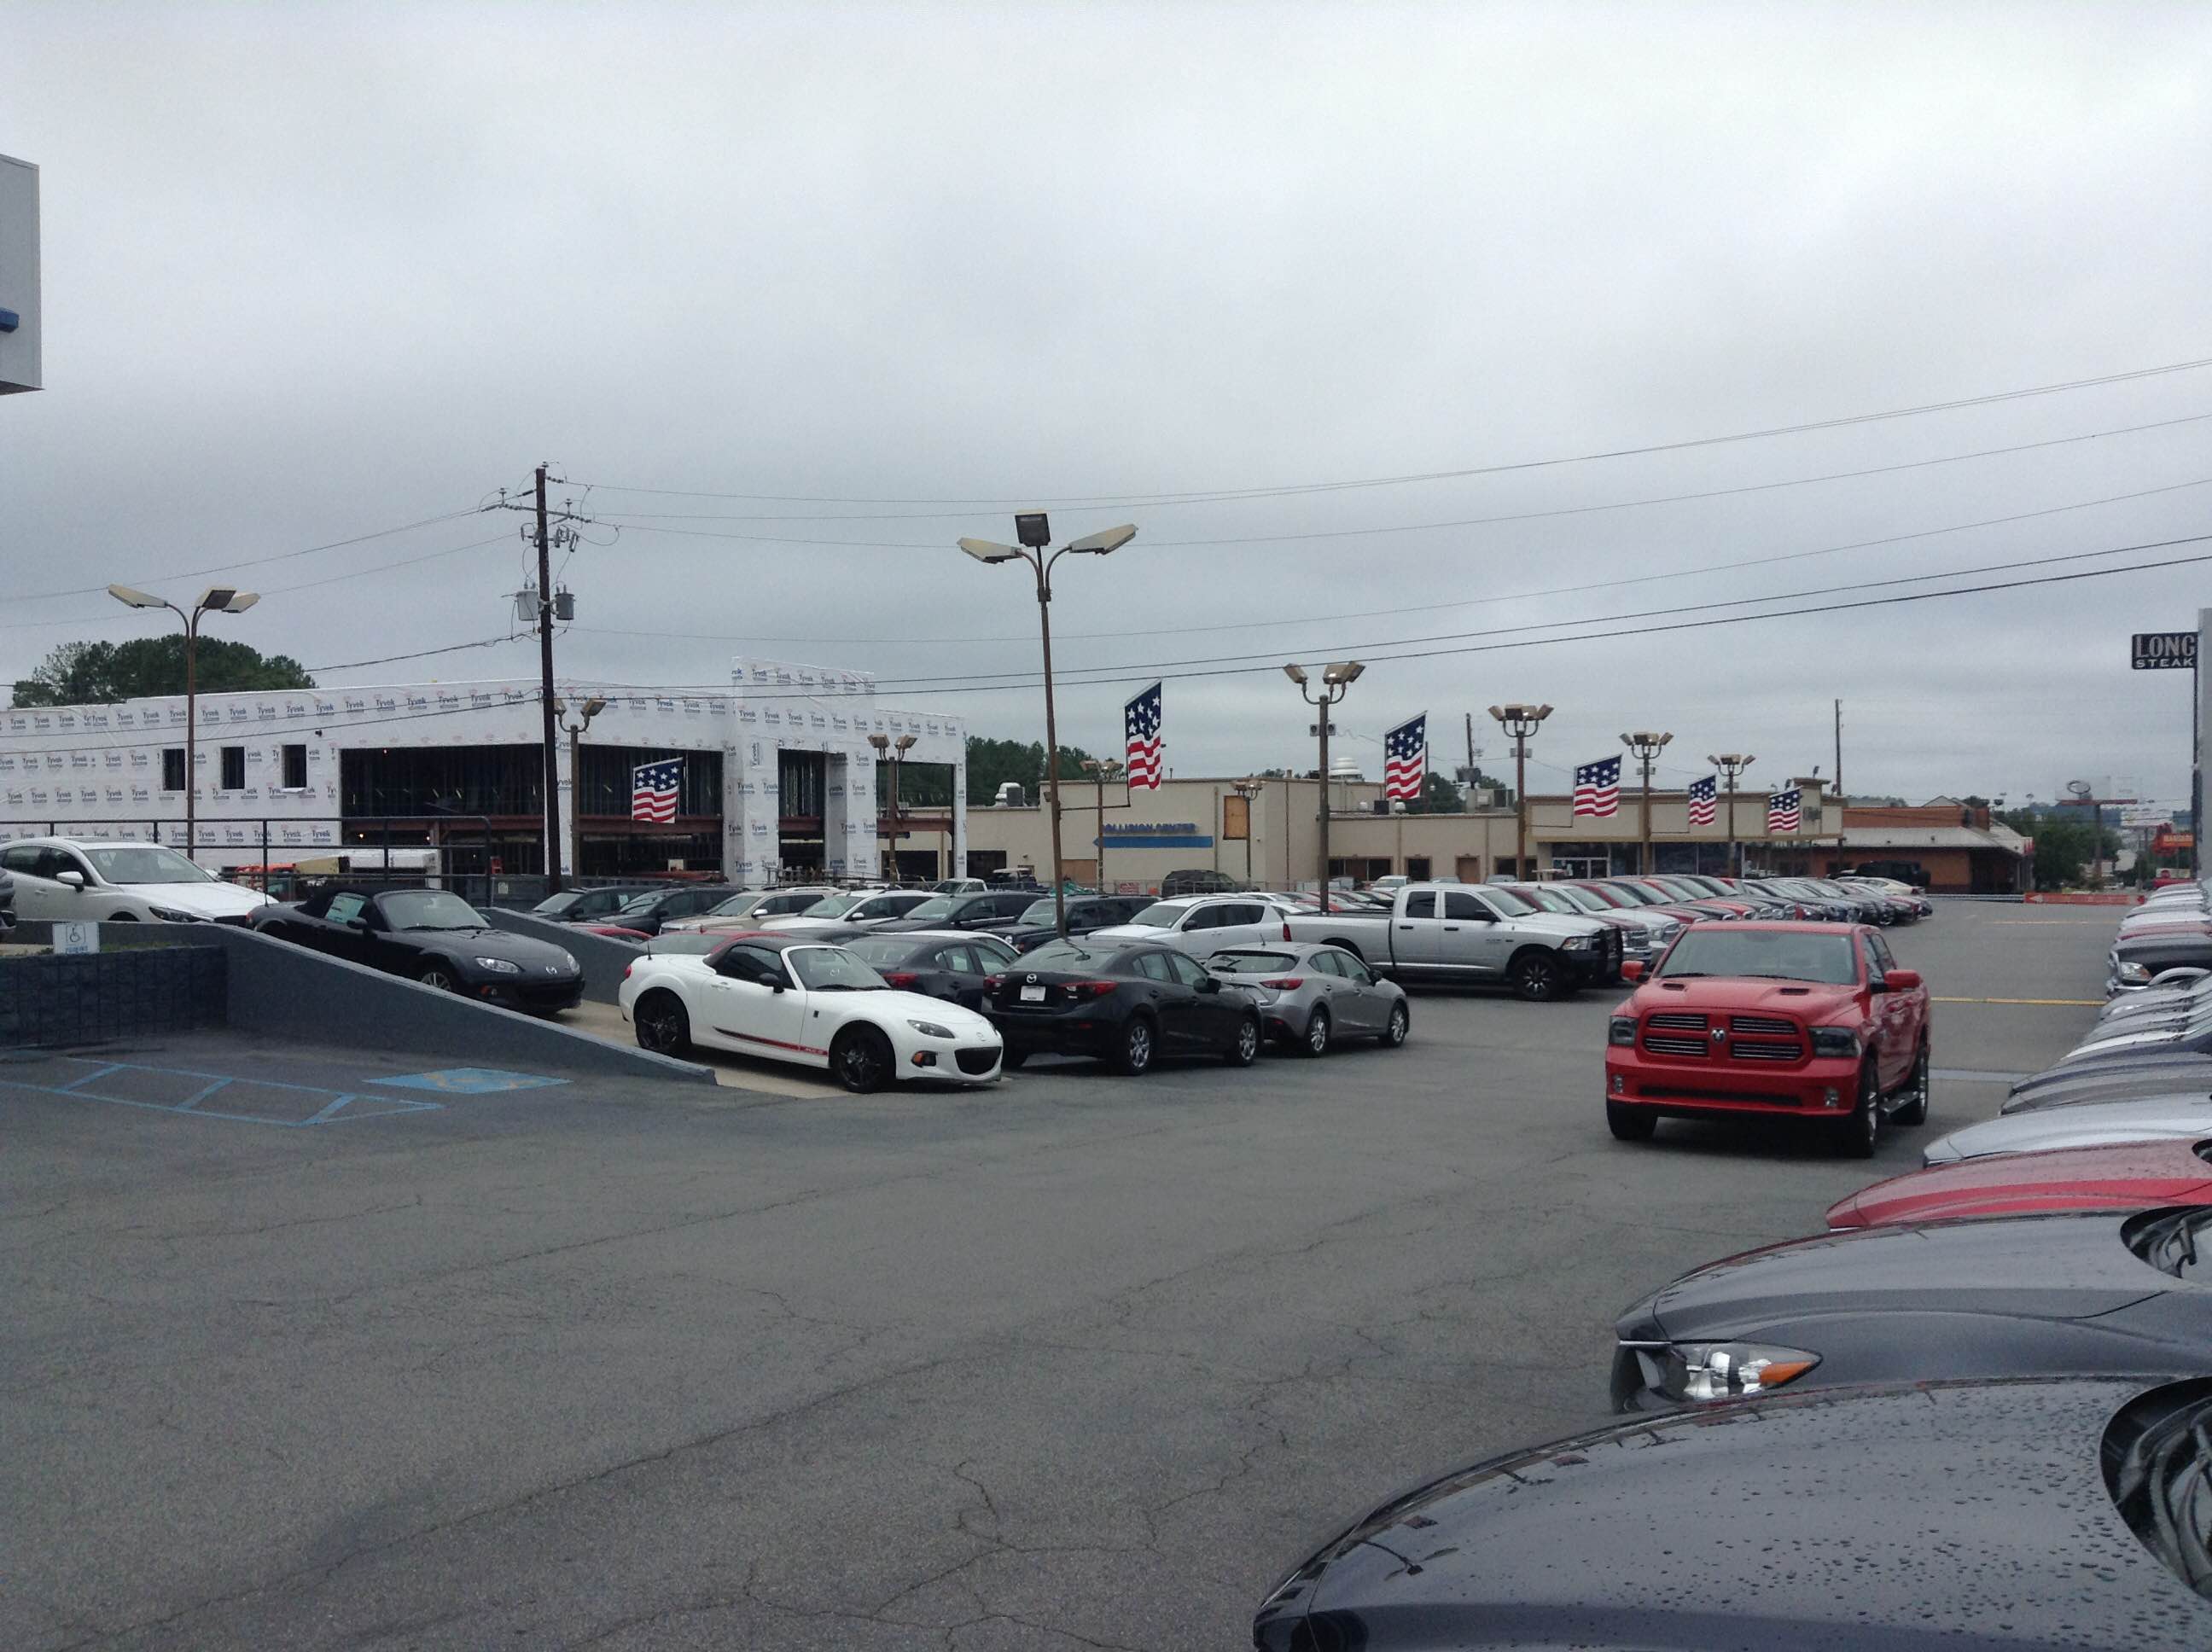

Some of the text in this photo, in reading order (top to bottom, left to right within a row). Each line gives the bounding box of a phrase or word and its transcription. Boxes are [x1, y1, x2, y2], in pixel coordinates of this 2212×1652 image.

[2135, 635, 2196, 658] LONG
[2136, 659, 2193, 668] STEAK
[287, 705, 305, 713] Tyvek
[316, 704, 334, 713] Tyvek
[346, 700, 364, 709] Tyvek
[376, 699, 394, 707] Tyvek
[407, 697, 426, 706] Tyvek
[311, 829, 330, 839] Tyvek
